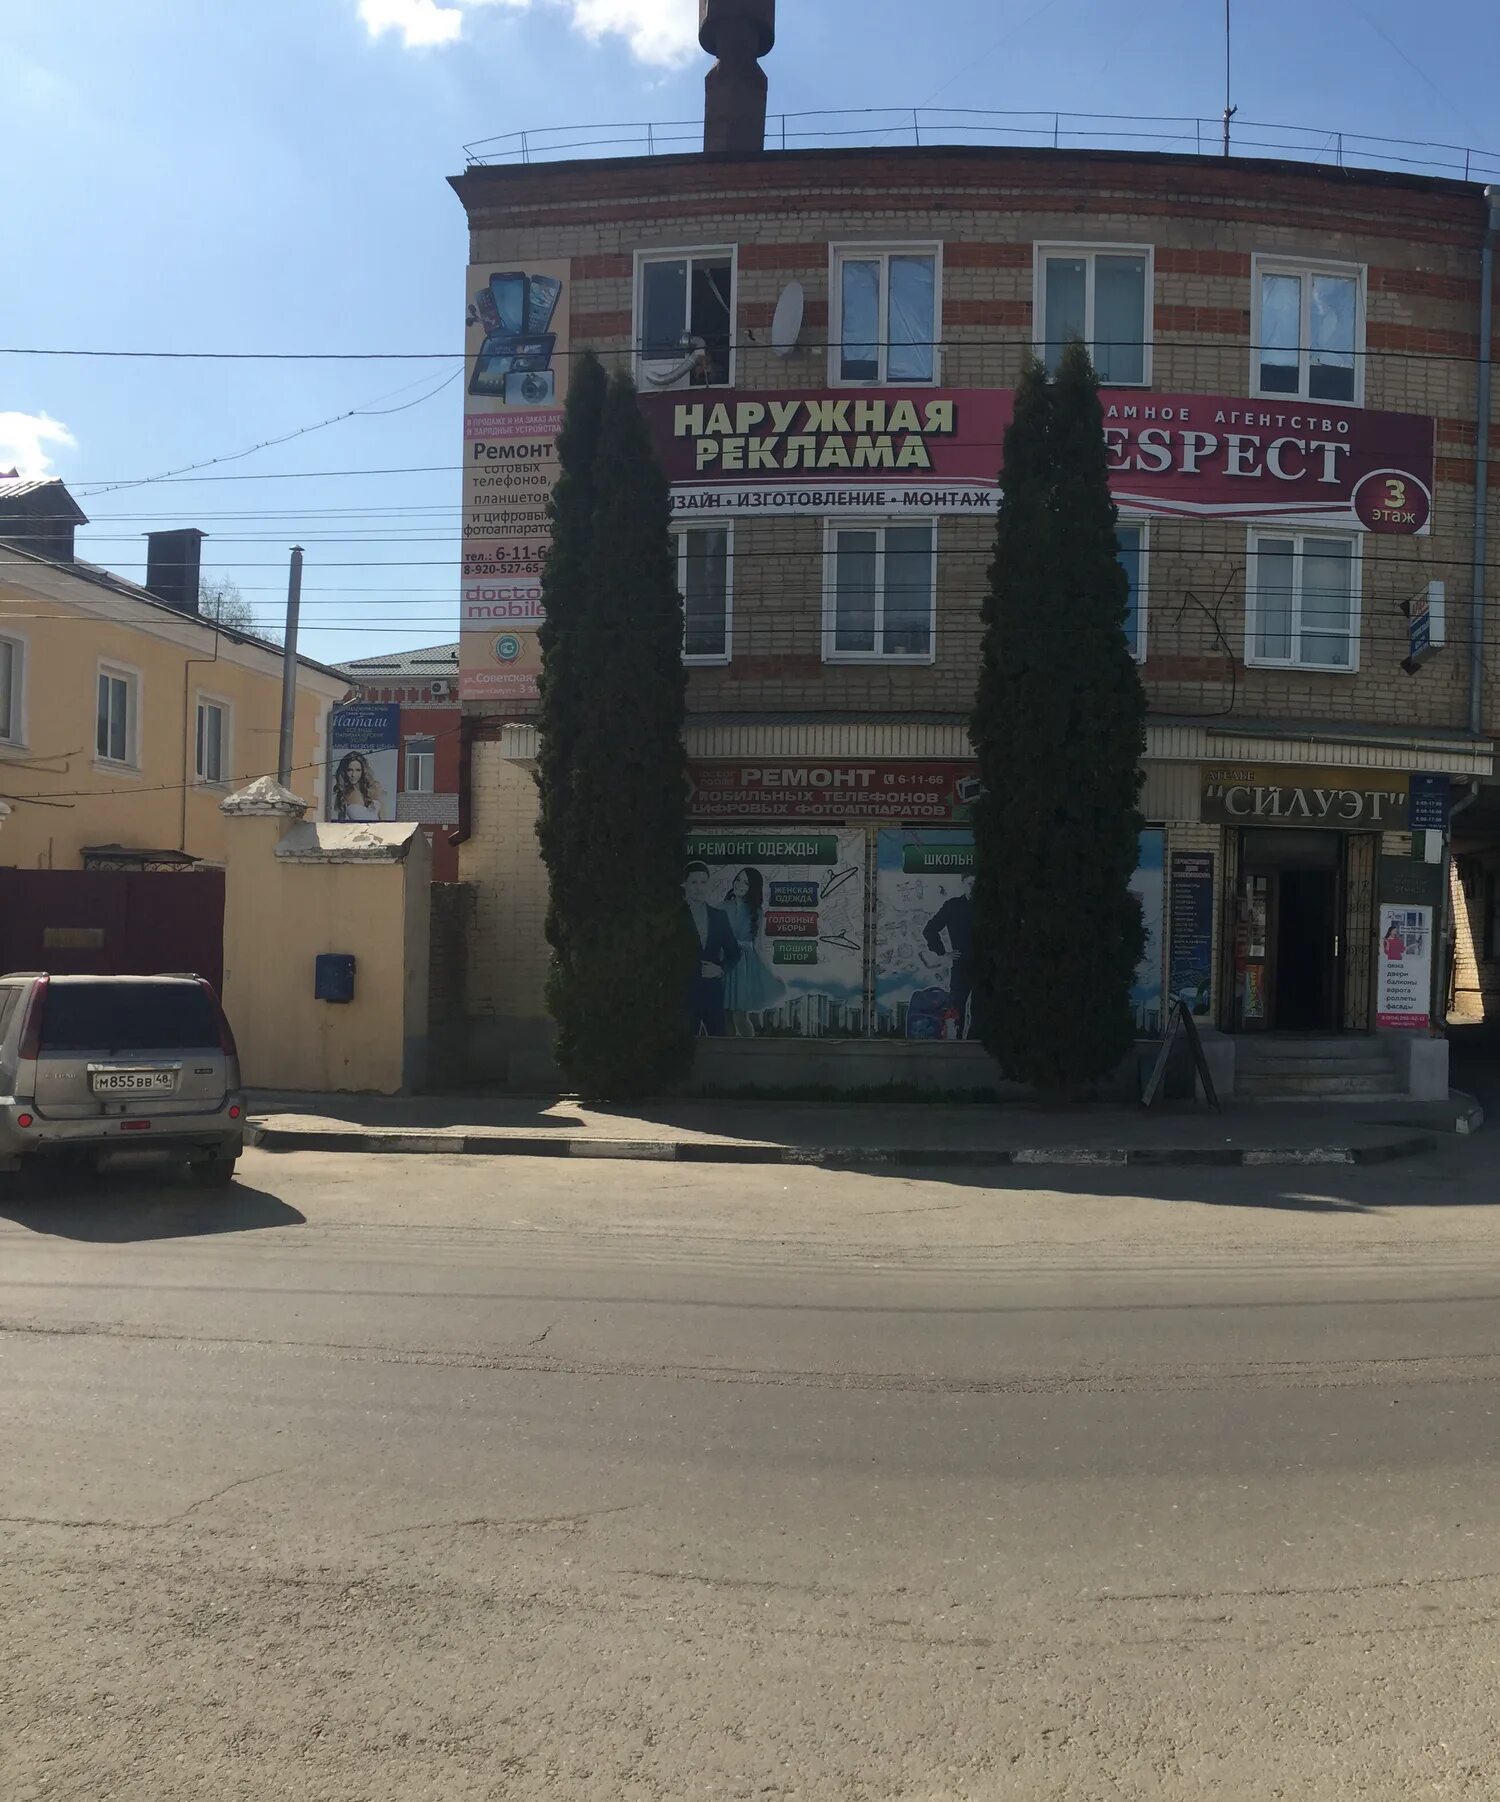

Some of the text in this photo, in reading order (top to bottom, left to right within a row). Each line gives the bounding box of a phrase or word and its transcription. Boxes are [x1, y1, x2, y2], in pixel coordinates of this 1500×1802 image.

[526, 416, 547, 424] ЗАКАЗ
[674, 400, 953, 436] НАРУЖНАЯ
[1215, 411, 1350, 434] АГЕНТСТВО
[474, 427, 513, 435] ЗАРЯДНЫЕ
[474, 443, 553, 460] Ремонт
[696, 435, 931, 471] РЕКЛАМА
[484, 464, 541, 474] сотовых
[473, 475, 551, 488] телефонов,
[474, 493, 550, 505] планшетов
[737, 492, 886, 507] ИЗГОТОВЛЕНИЕ
[903, 492, 991, 507] МОНТАЖ
[1384, 479, 1406, 509] 3
[473, 510, 552, 524] и цифровых
[1372, 507, 1416, 525] этаж
[465, 552, 492, 562] тел.:
[476, 673, 536, 684] Советская,
[741, 769, 944, 787] РЕМОНТ 6-11-66
[699, 791, 939, 803] МОБИЛЬНЫХ ТЕЛЕФОНОВ
[692, 803, 946, 816] ЦИФРОВЫХ ФОТОАППАРАТОВ
[699, 843, 754, 856] РЕМОНТ
[758, 843, 819, 856] ОДЕЖДЫ
[774, 887, 814, 895] ЖЕНСКАЯ
[775, 895, 814, 904] ОДЕЖДА
[768, 916, 815, 925] ГОЛОВНЫЕ
[777, 924, 806, 933] УБОРЫ
[779, 944, 813, 953] ПОШИВ
[783, 952, 809, 961] ШТОР
[1386, 971, 1409, 979] двери
[99, 1074, 169, 1088] М855ВВ 48
